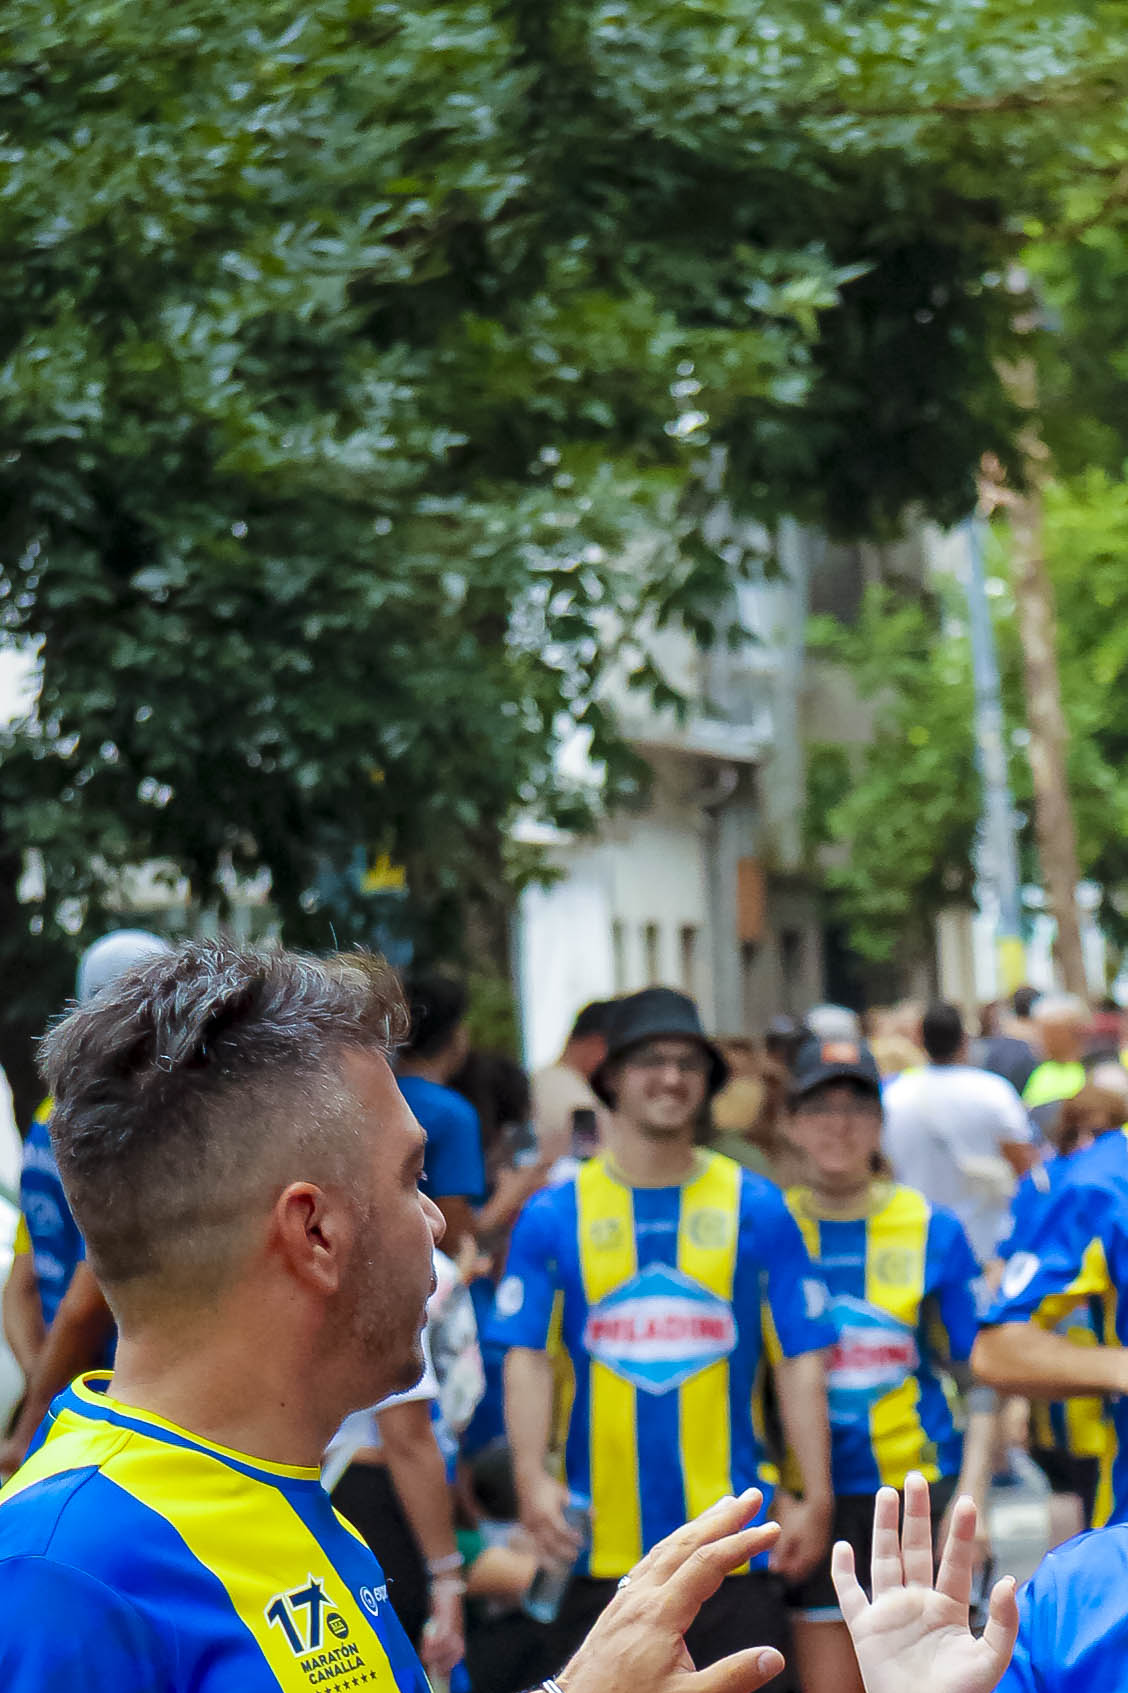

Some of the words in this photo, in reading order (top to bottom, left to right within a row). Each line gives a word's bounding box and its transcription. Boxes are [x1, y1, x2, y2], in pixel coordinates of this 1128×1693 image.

[265, 1575, 334, 1657] 17
[301, 1641, 359, 1673] MARATÓN
[309, 1656, 365, 1684] CANALLA
